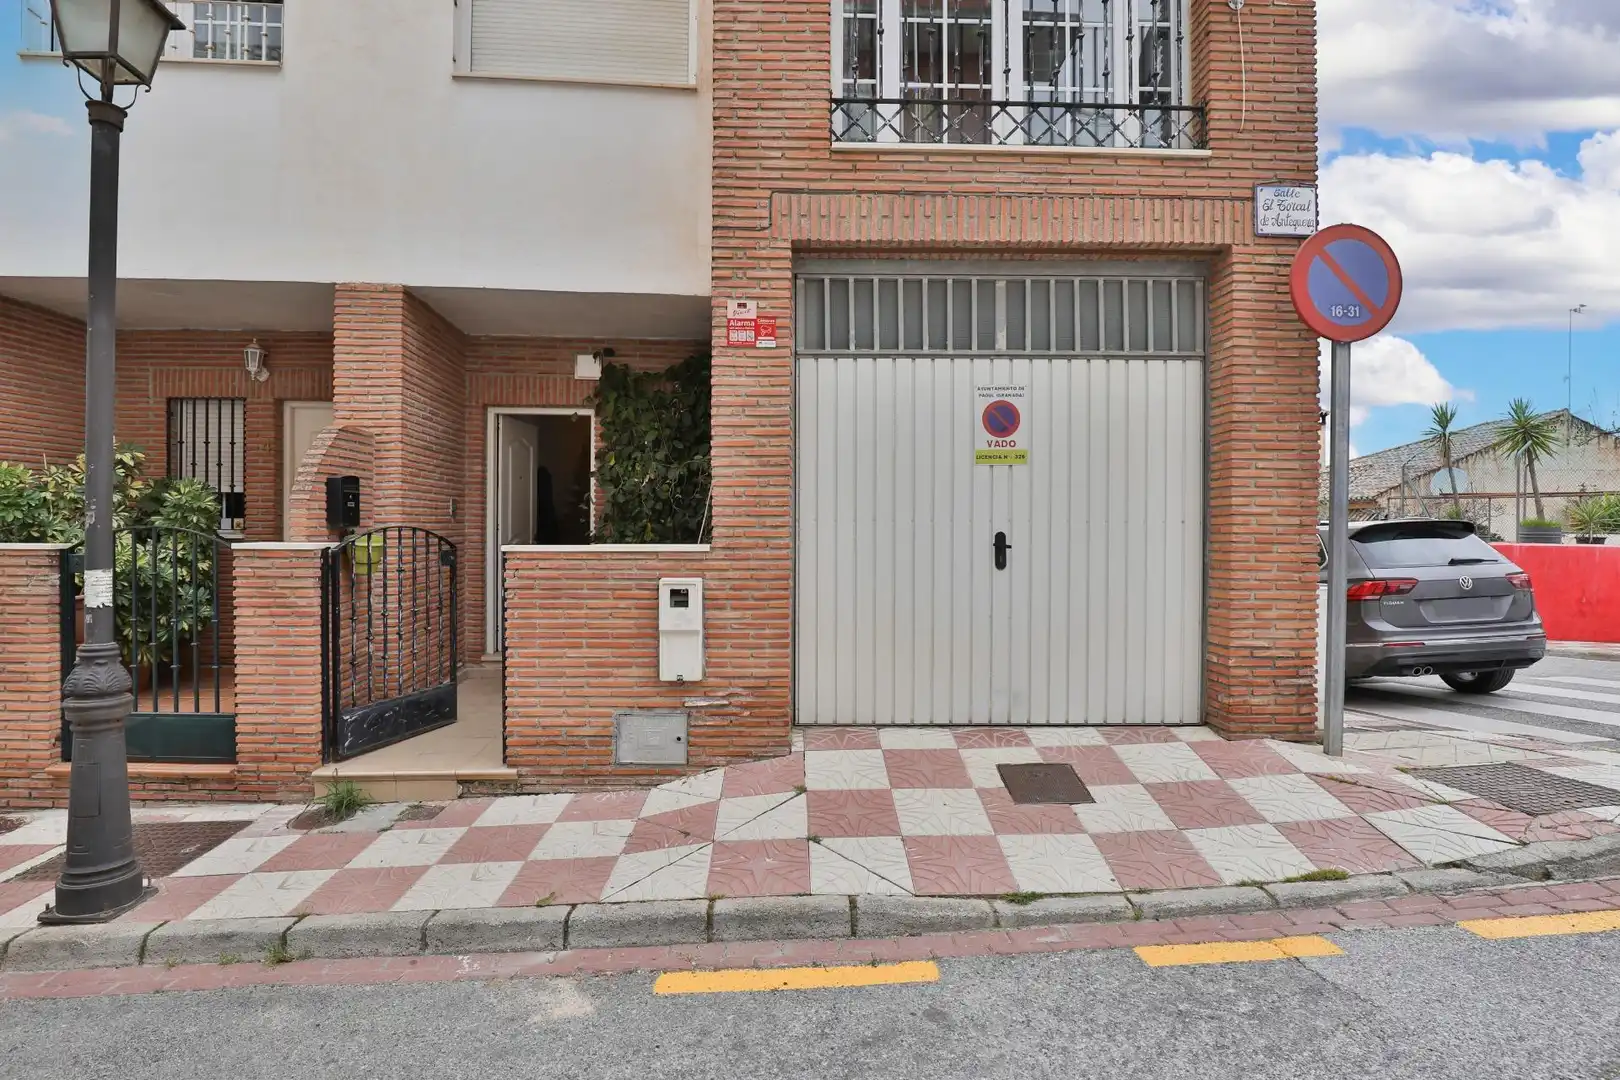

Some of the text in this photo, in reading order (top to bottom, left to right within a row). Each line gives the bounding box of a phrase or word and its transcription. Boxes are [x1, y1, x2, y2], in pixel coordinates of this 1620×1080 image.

[1273, 188, 1301, 198] Calle
[1262, 198, 1313, 212] El Torcal
[1259, 213, 1270, 226] de
[1330, 304, 1360, 317] 16-31
[729, 319, 755, 327] Alarma
[986, 440, 1017, 448] VADO
